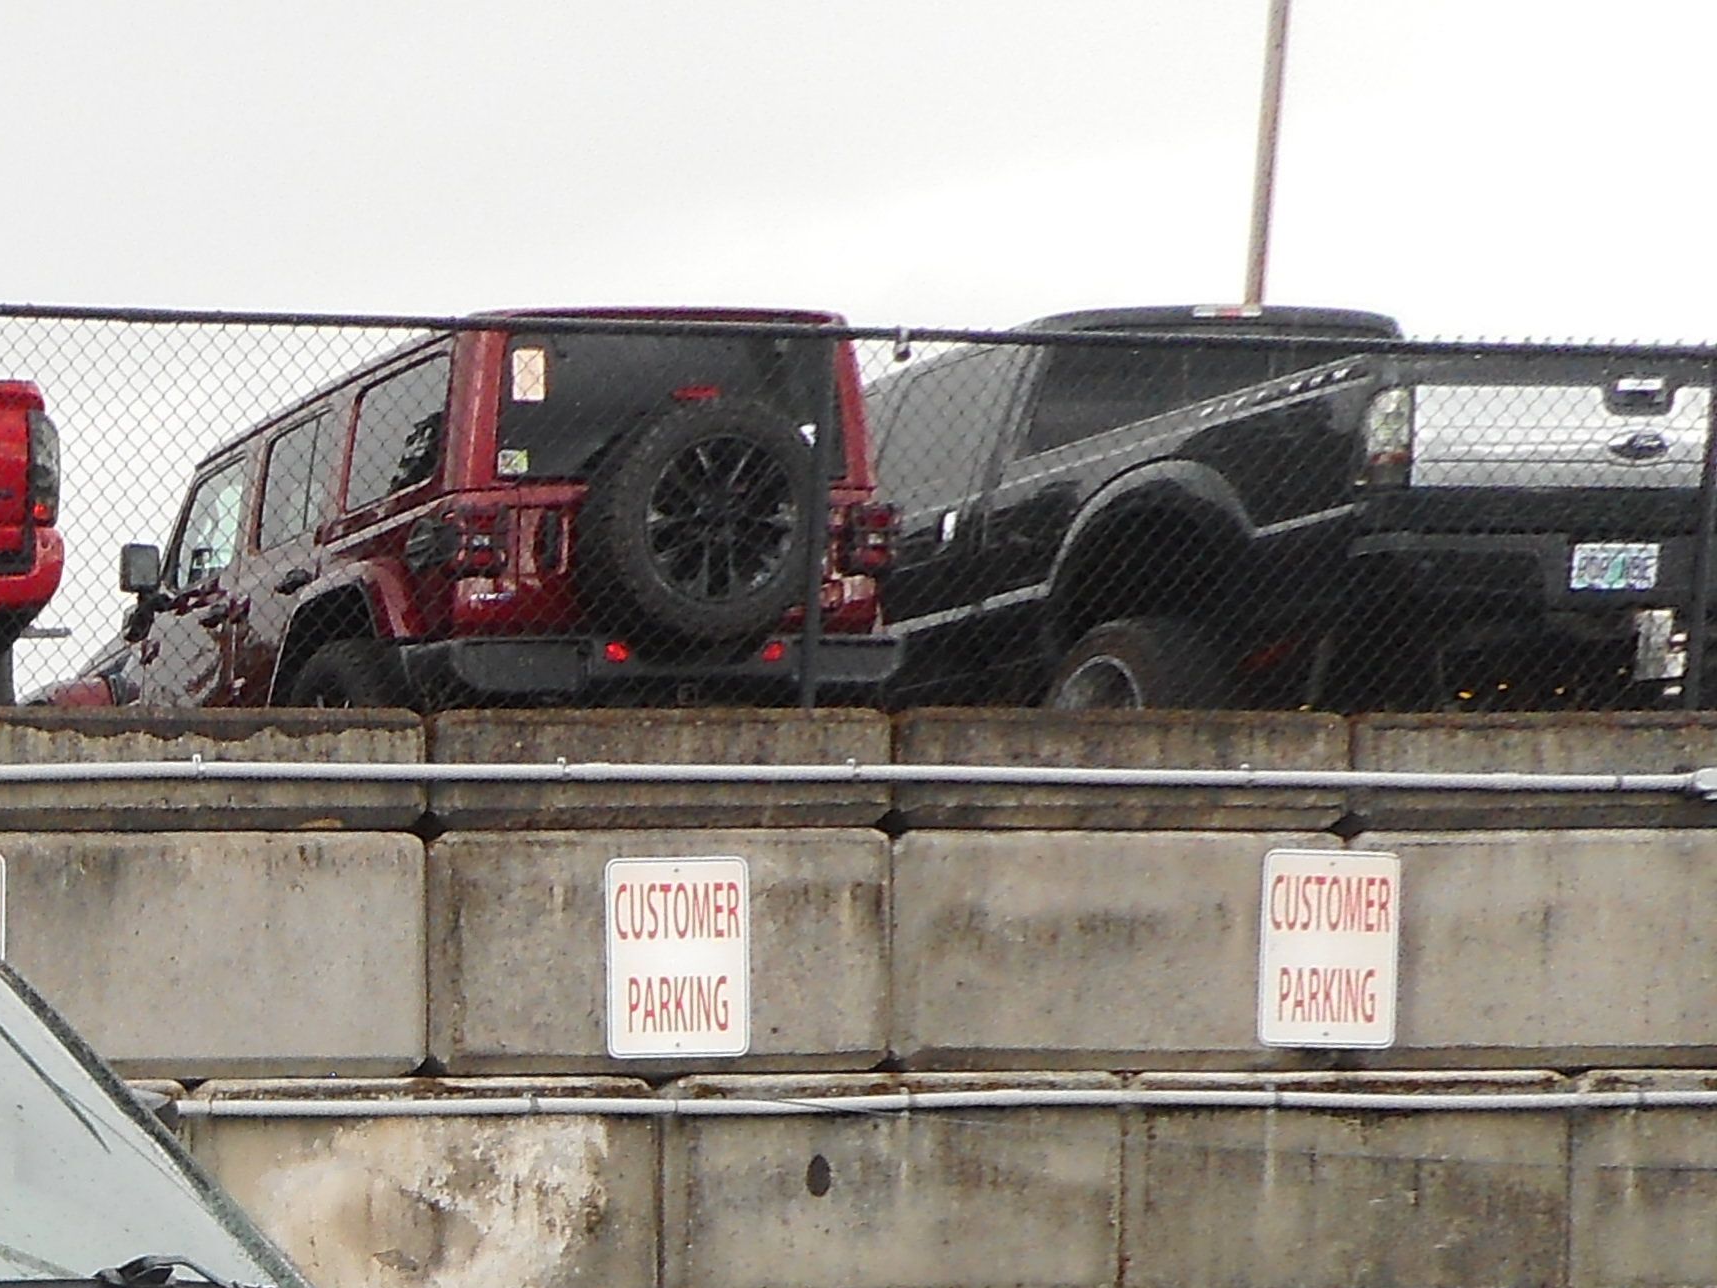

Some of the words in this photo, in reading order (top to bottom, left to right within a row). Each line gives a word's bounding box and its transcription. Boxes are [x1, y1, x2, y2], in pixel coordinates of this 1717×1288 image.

[614, 881, 741, 941] CUSTOMER
[1269, 874, 1392, 933] CUSTOMER
[627, 974, 730, 1034] PARKING
[1277, 966, 1377, 1024] PARKING
